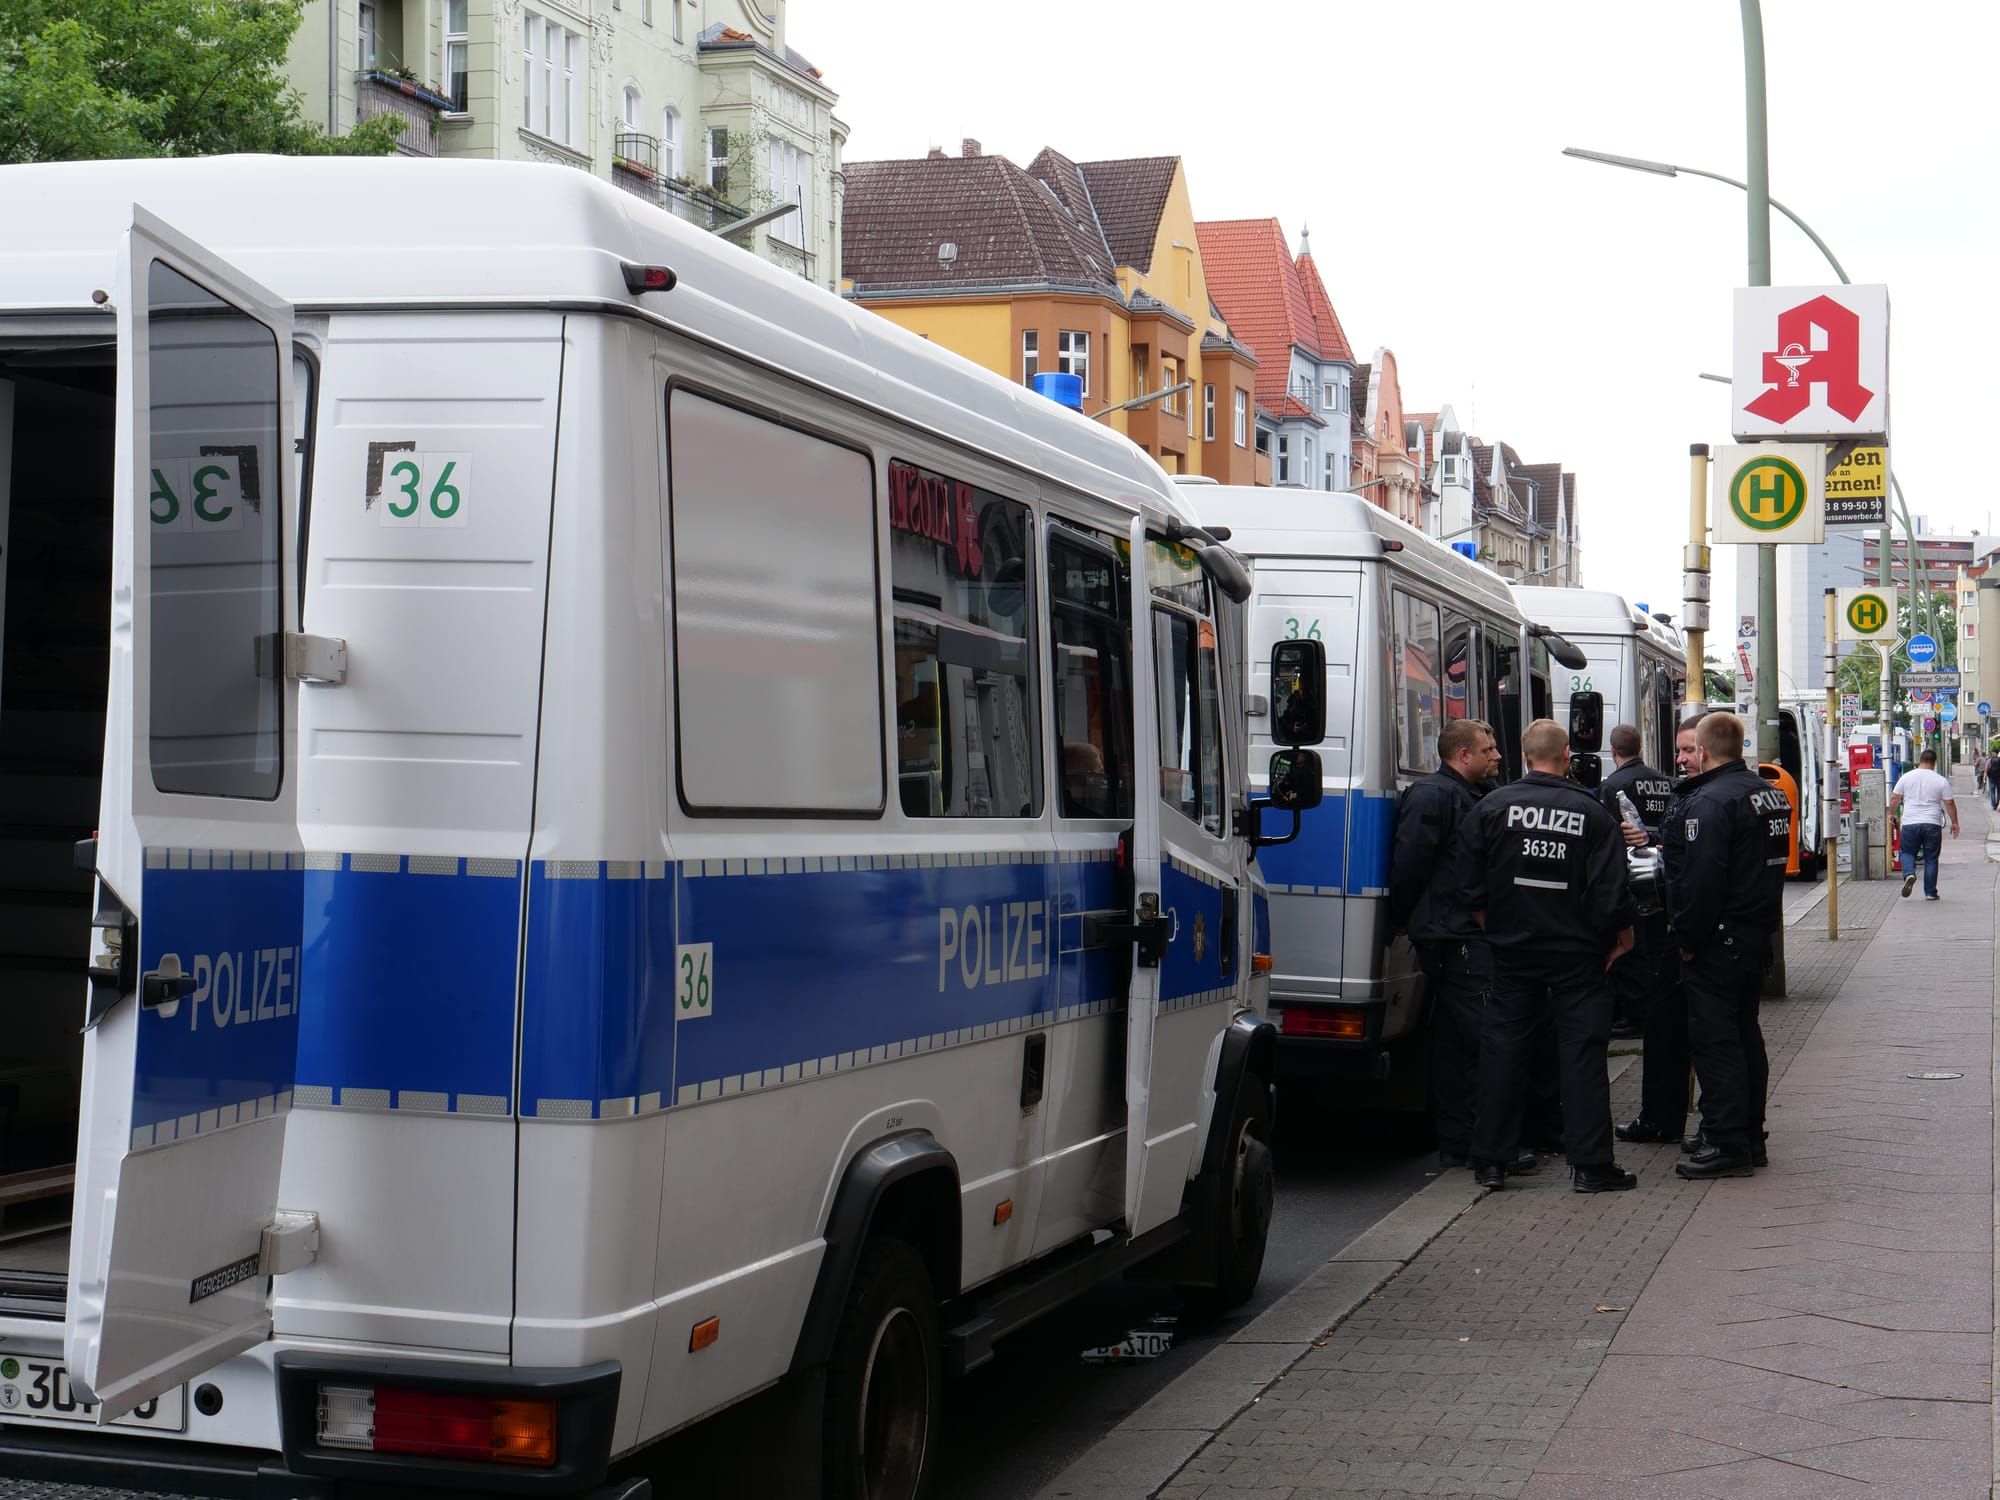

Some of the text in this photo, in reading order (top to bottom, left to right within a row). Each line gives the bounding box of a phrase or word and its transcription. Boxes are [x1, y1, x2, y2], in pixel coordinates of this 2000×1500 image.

[388, 461, 461, 519] 36
[1750, 474, 1784, 513] H
[1825, 475, 1881, 492] ernen!
[1825, 512, 1883, 521] ussenwerber.de
[1833, 502, 1839, 511] 8
[1842, 501, 1868, 511] 99-50
[1858, 604, 1876, 624] H
[1284, 617, 1322, 640] 36
[1571, 675, 1592, 692] 36
[1901, 675, 1933, 684] Borkumer
[1507, 805, 1585, 836] POLIZEI
[1522, 838, 1567, 860] 3632R
[938, 900, 1050, 992] POLIZEI
[190, 946, 300, 1032] POLIZEI
[680, 951, 709, 1010] 36
